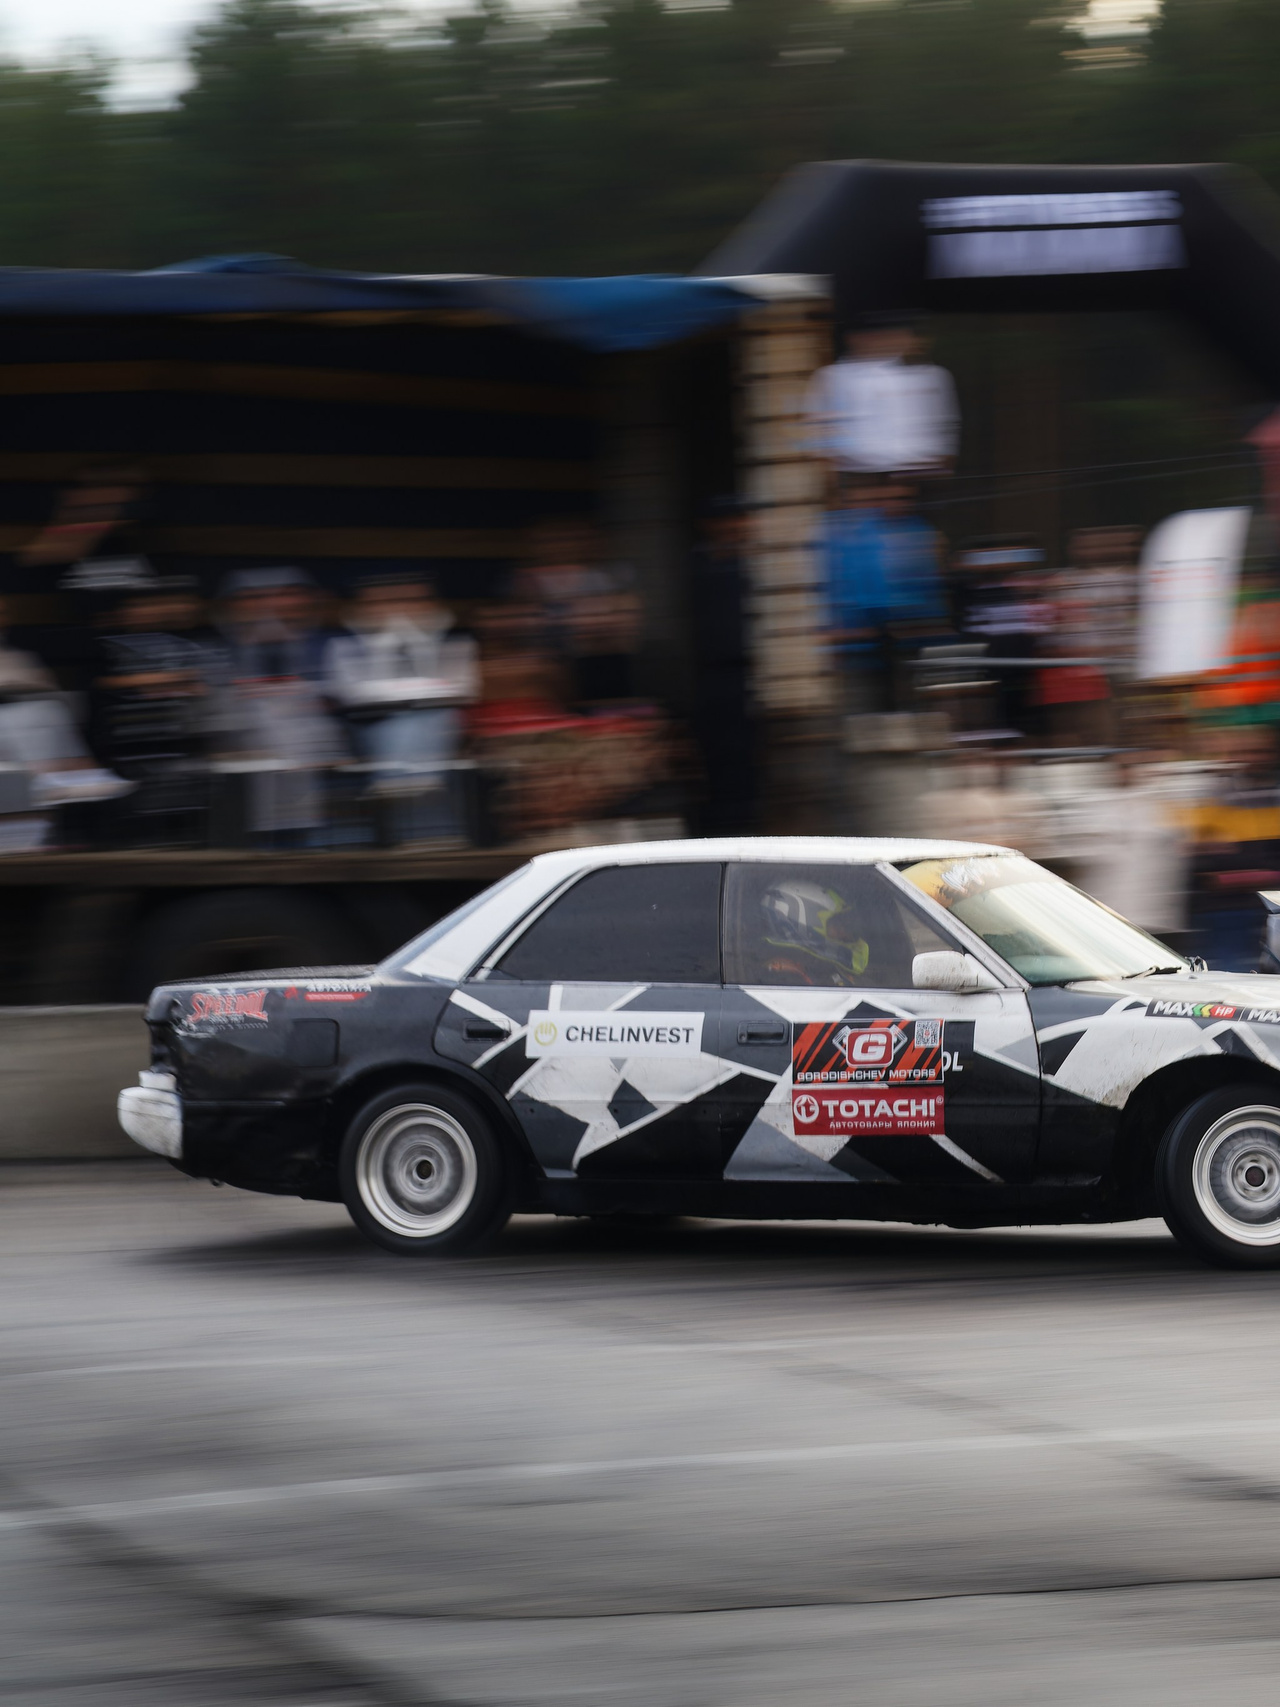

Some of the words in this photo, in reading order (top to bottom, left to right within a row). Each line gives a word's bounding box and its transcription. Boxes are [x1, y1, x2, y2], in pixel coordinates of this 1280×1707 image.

[1153, 1000, 1195, 1017] MAX
[1214, 1006, 1233, 1017] HP
[565, 1025, 694, 1044] CHELINVEST
[797, 1070, 886, 1082] GORODISHCHEV
[889, 1068, 936, 1079] MOTORS
[822, 1099, 935, 1118] TOTACHI
[829, 1120, 892, 1129] АВТОТОВАРЫ
[897, 1120, 936, 1128] ЯПОНИЯ
